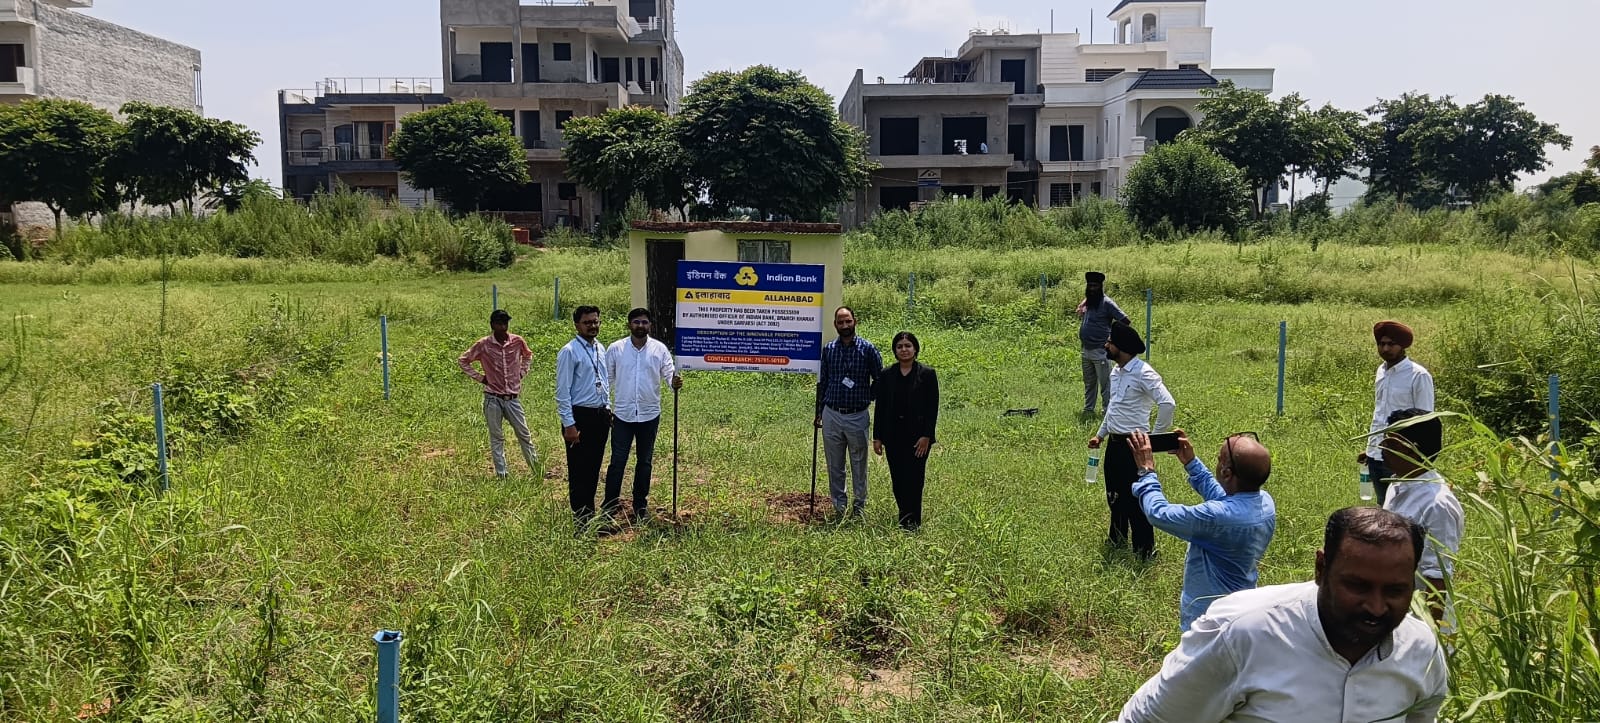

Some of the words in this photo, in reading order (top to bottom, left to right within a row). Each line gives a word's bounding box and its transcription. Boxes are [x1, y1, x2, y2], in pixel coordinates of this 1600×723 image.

[766, 274, 794, 282] Indian
[796, 274, 817, 282] Bank
[764, 294, 814, 302] ALLAHABAD
